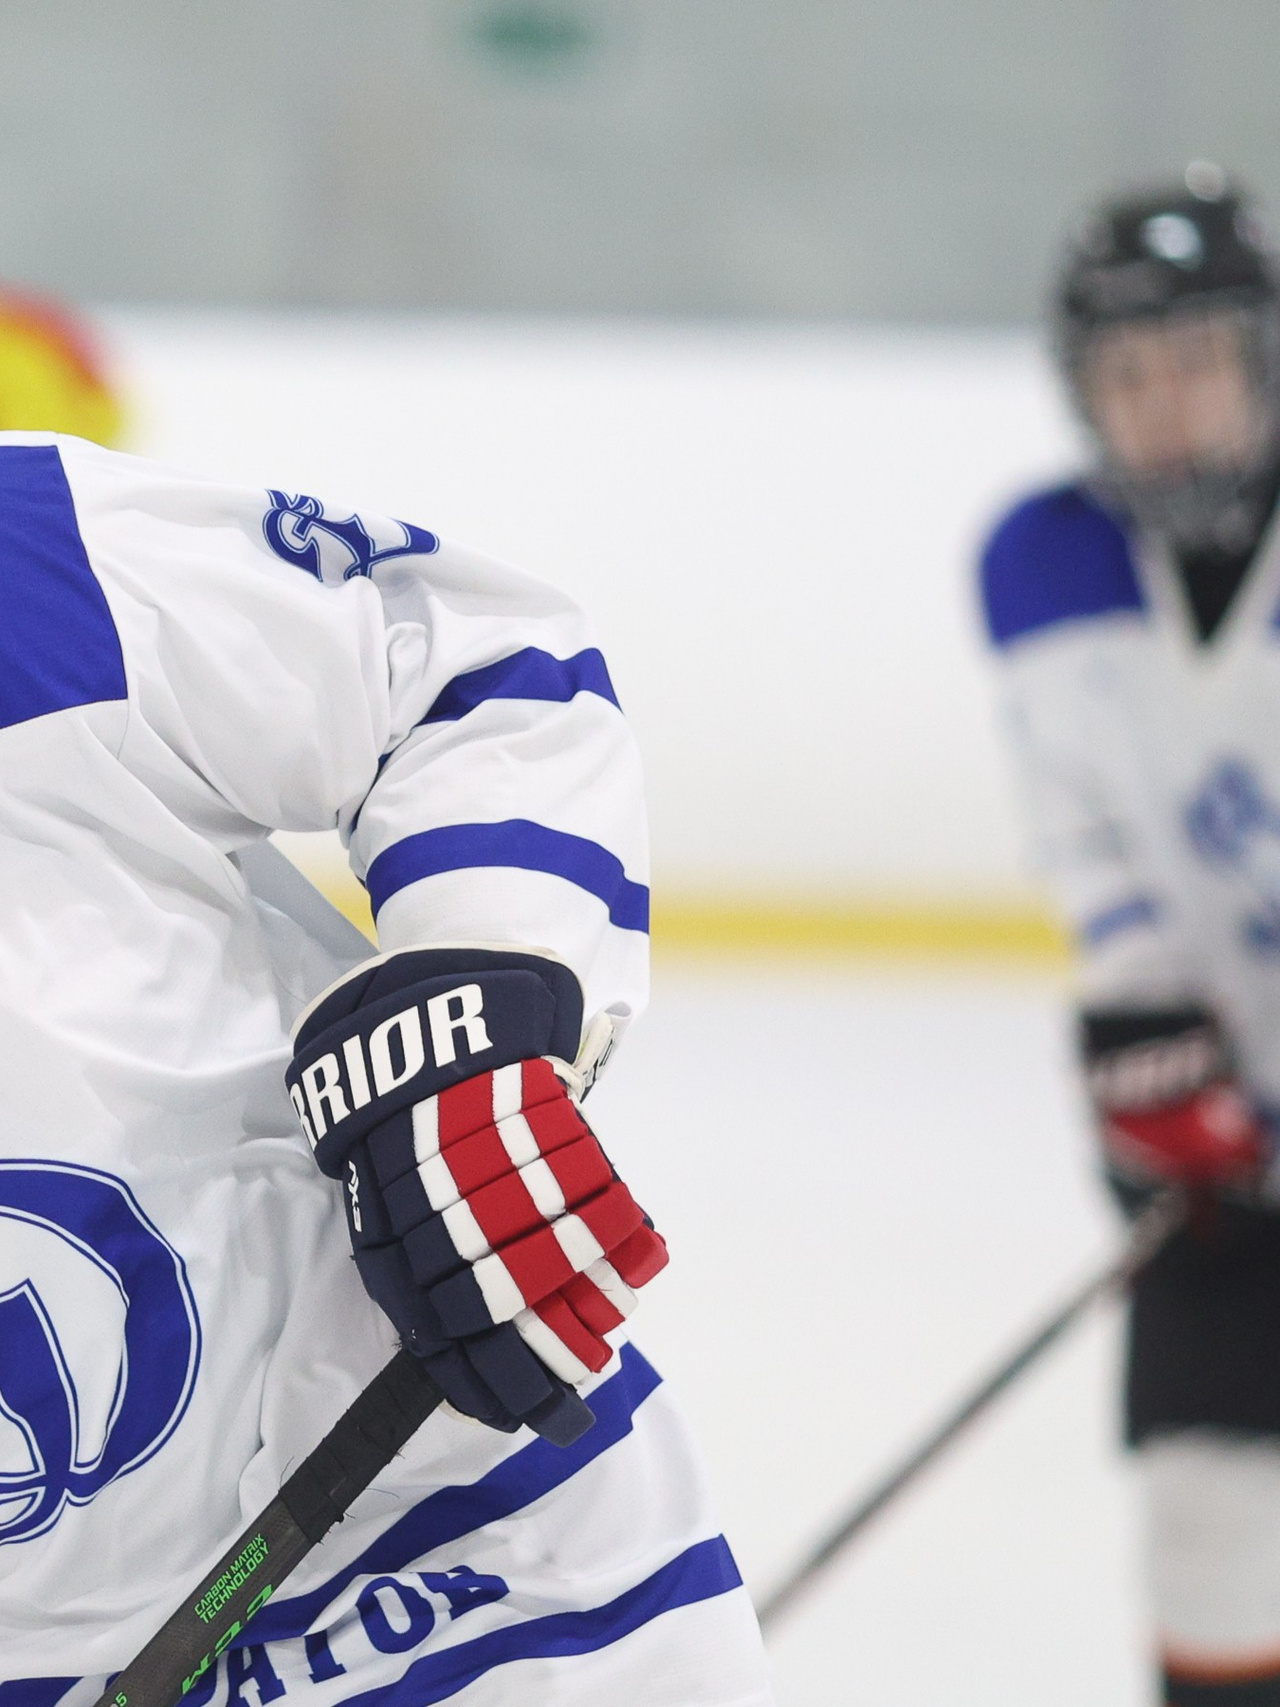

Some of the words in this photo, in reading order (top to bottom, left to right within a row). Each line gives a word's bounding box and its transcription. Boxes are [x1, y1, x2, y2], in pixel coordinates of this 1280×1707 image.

[194, 1570, 232, 1615] CARBON
[229, 1533, 265, 1574] MATRIX
[199, 1541, 269, 1624] TECHNOLOGY
